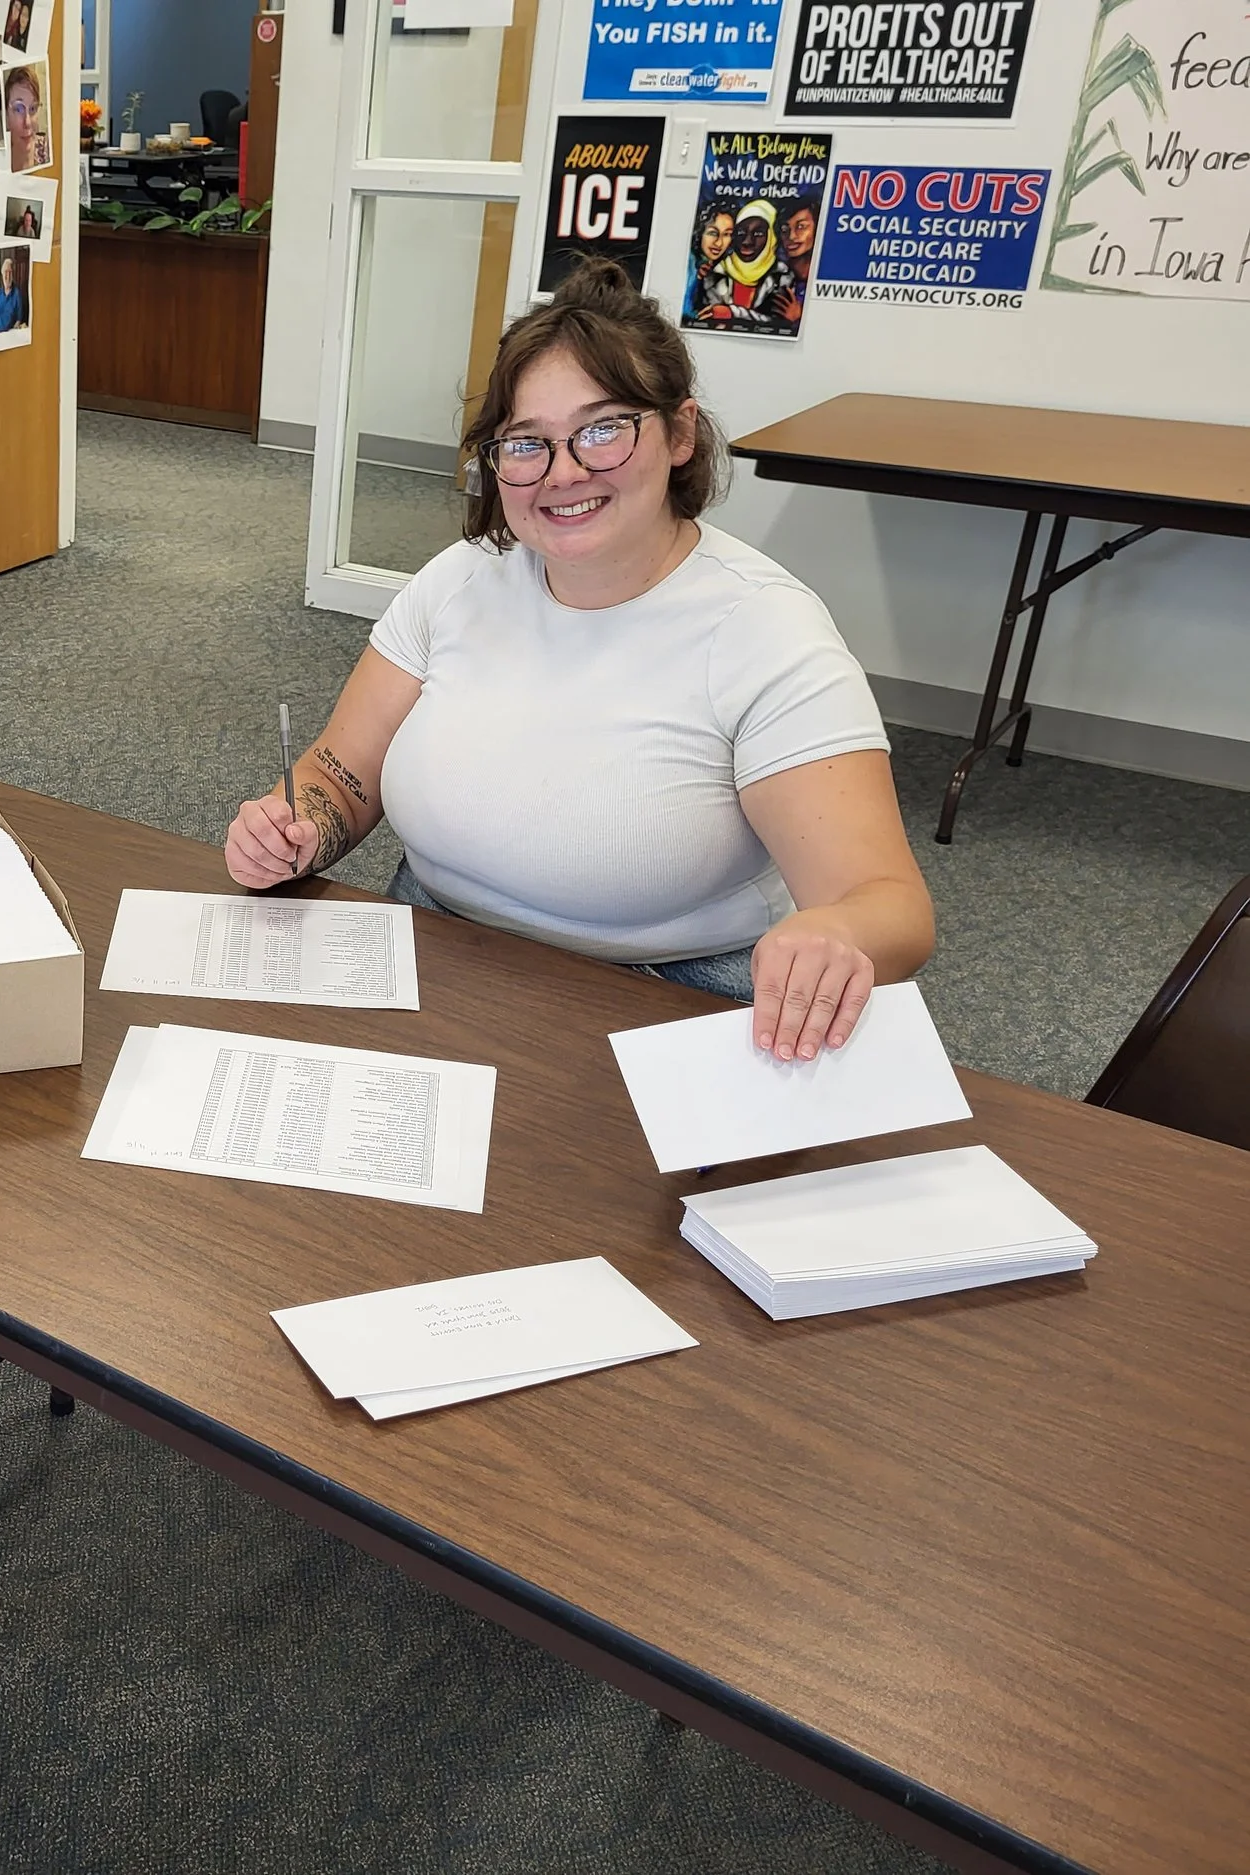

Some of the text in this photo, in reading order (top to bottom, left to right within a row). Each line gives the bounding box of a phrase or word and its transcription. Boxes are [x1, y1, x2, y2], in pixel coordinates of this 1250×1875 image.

[595, 21, 773, 44] You FISH in it.
[805, 1, 1024, 49] PROFITS OUT
[800, 48, 1015, 84] OF HEALTHCARE
[795, 87, 1005, 104] #UNPRIVATIZENOW #HEALTHCARE4ALL
[564, 143, 650, 170] ABOLISH
[711, 135, 730, 156] We
[730, 134, 757, 155] ALL
[757, 134, 798, 164] Belong
[1145, 131, 1250, 187] Why are
[704, 160, 725, 181] We
[727, 159, 758, 181] Will
[833, 169, 1045, 215] NO CUTS
[557, 173, 645, 240] ICE
[836, 214, 1028, 240] SOCIAL SECURITY
[868, 239, 983, 261] MEDICARE
[1088, 231, 1126, 276] in
[1134, 217, 1224, 283] Iowa
[866, 261, 976, 284] MEDICAID
[816, 283, 1023, 309] WWW.SAYNOCUTS.ORG
